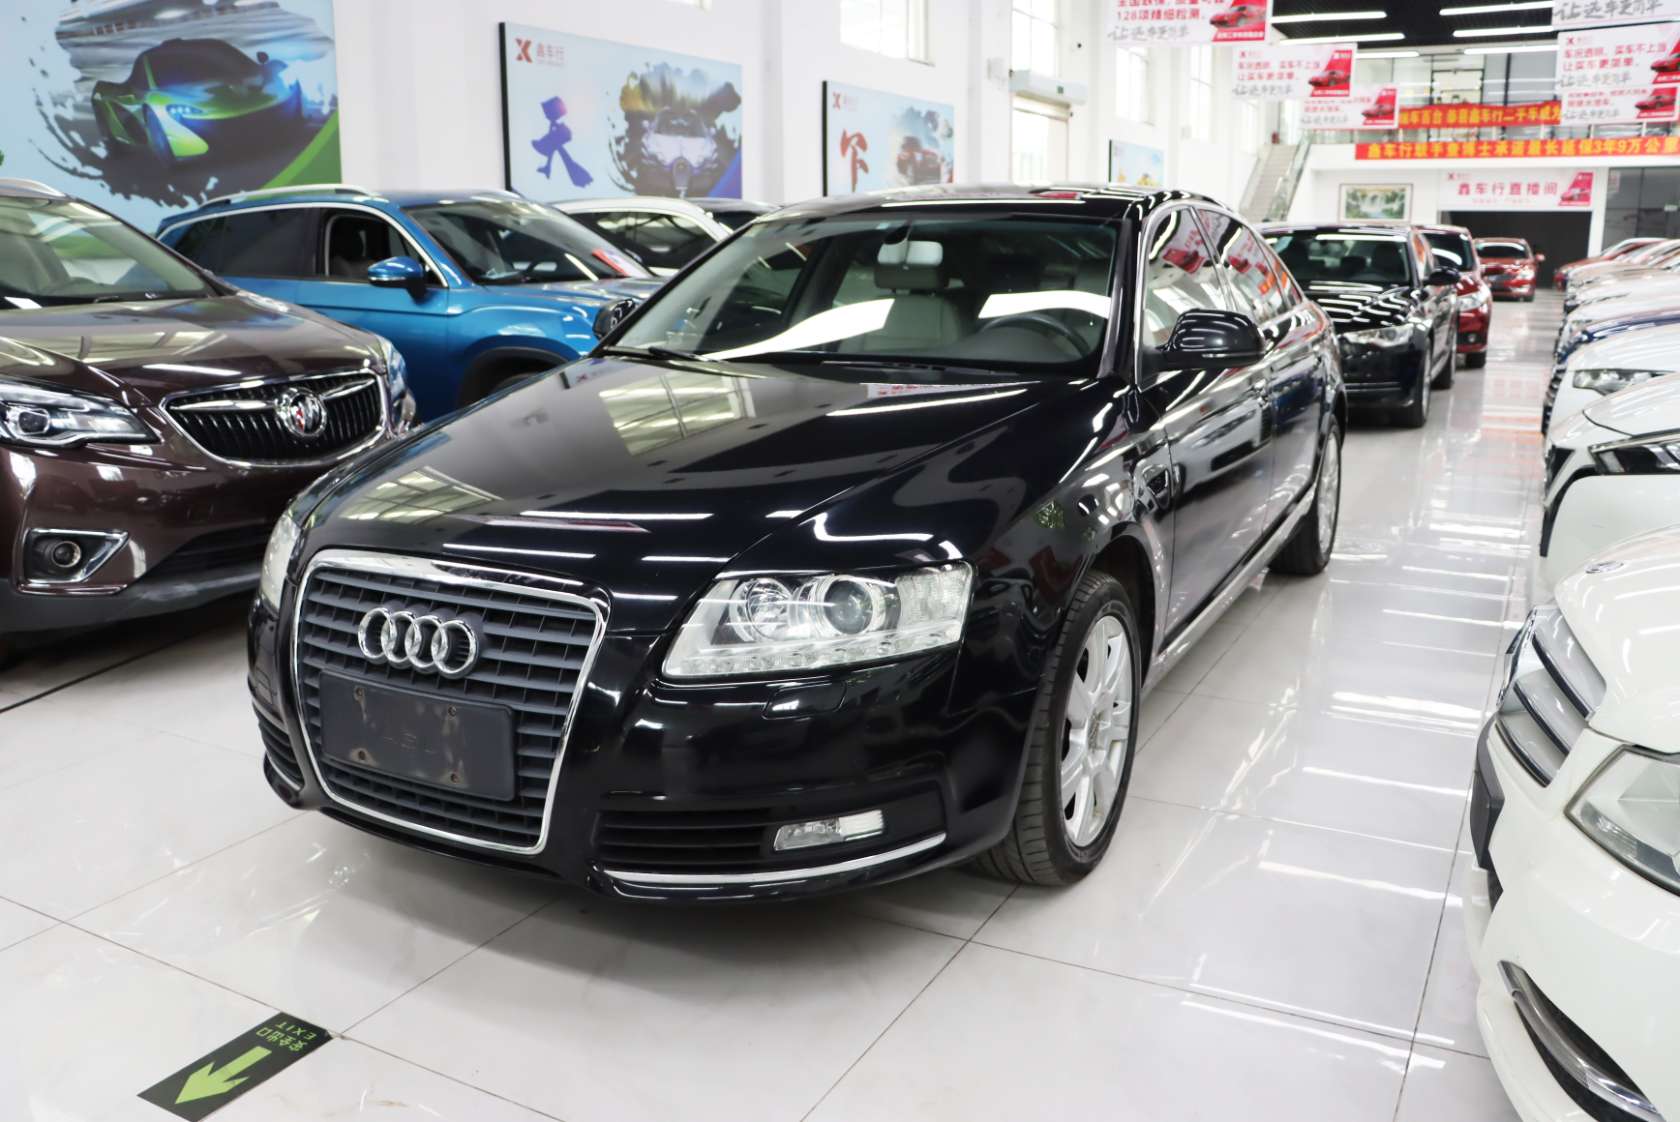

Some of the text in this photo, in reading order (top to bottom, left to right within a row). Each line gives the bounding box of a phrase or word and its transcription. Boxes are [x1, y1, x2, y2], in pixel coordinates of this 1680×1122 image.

[255, 1026, 308, 1052] 安全出口
[275, 1021, 317, 1041] EXIT
